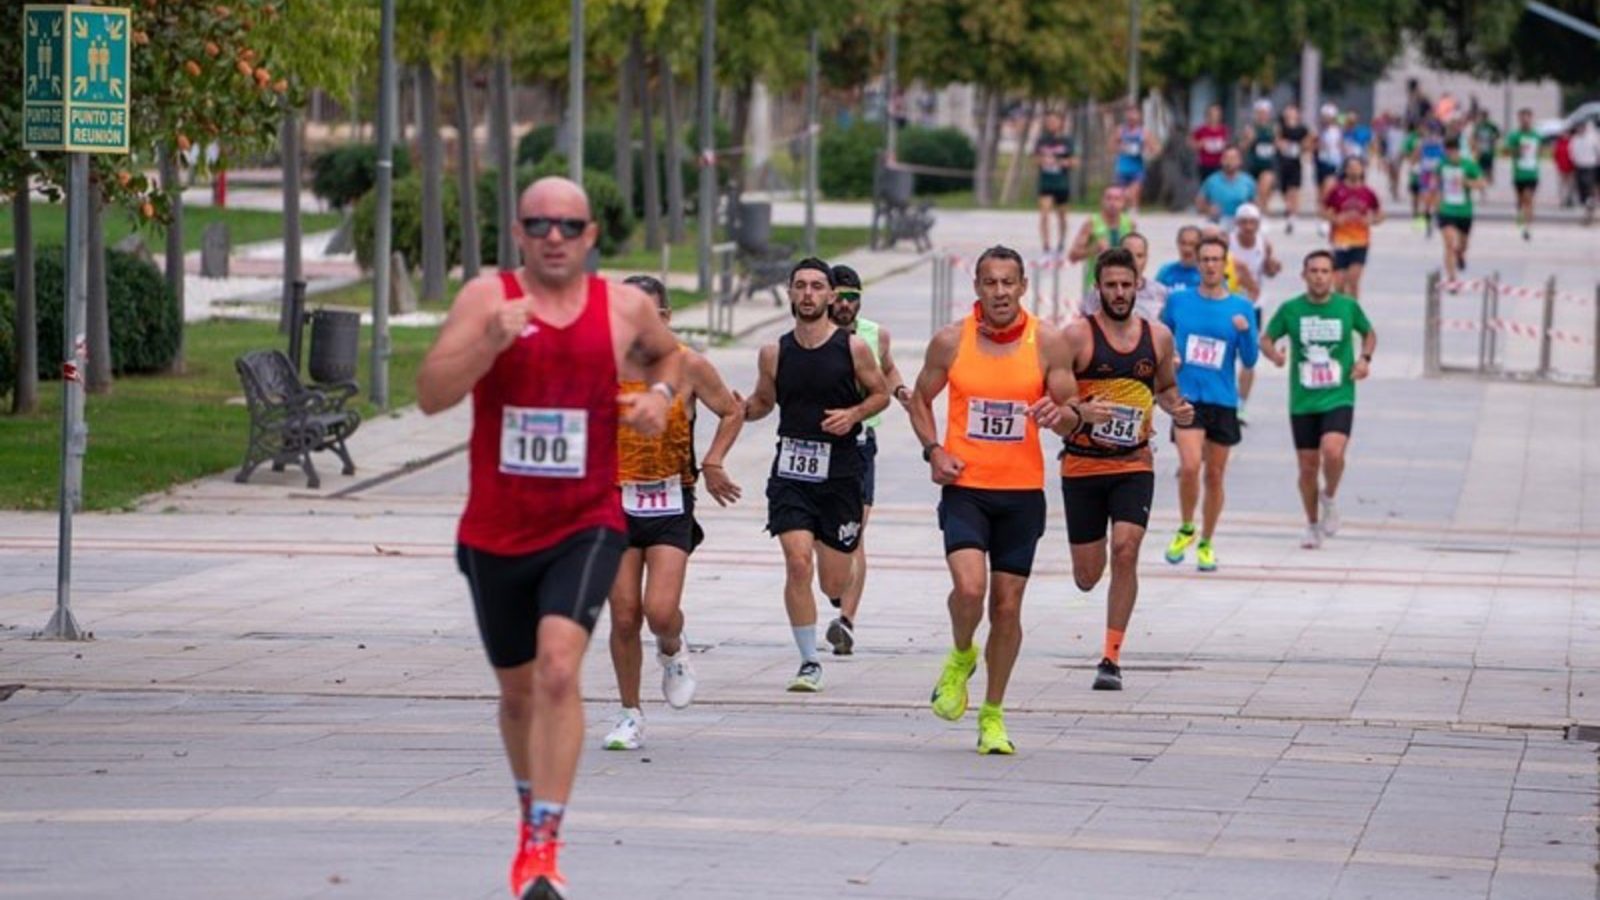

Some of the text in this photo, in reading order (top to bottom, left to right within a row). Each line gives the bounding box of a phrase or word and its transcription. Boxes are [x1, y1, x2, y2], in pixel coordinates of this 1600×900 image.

[27, 108, 63, 123] PUNTO DE
[72, 109, 124, 126] PUNTO DE
[74, 126, 122, 144] REUNIÓN
[980, 416, 1014, 435] 157
[1102, 419, 1134, 438] 354
[517, 436, 568, 463] 100
[789, 456, 819, 475] 138
[635, 491, 667, 508] 711
